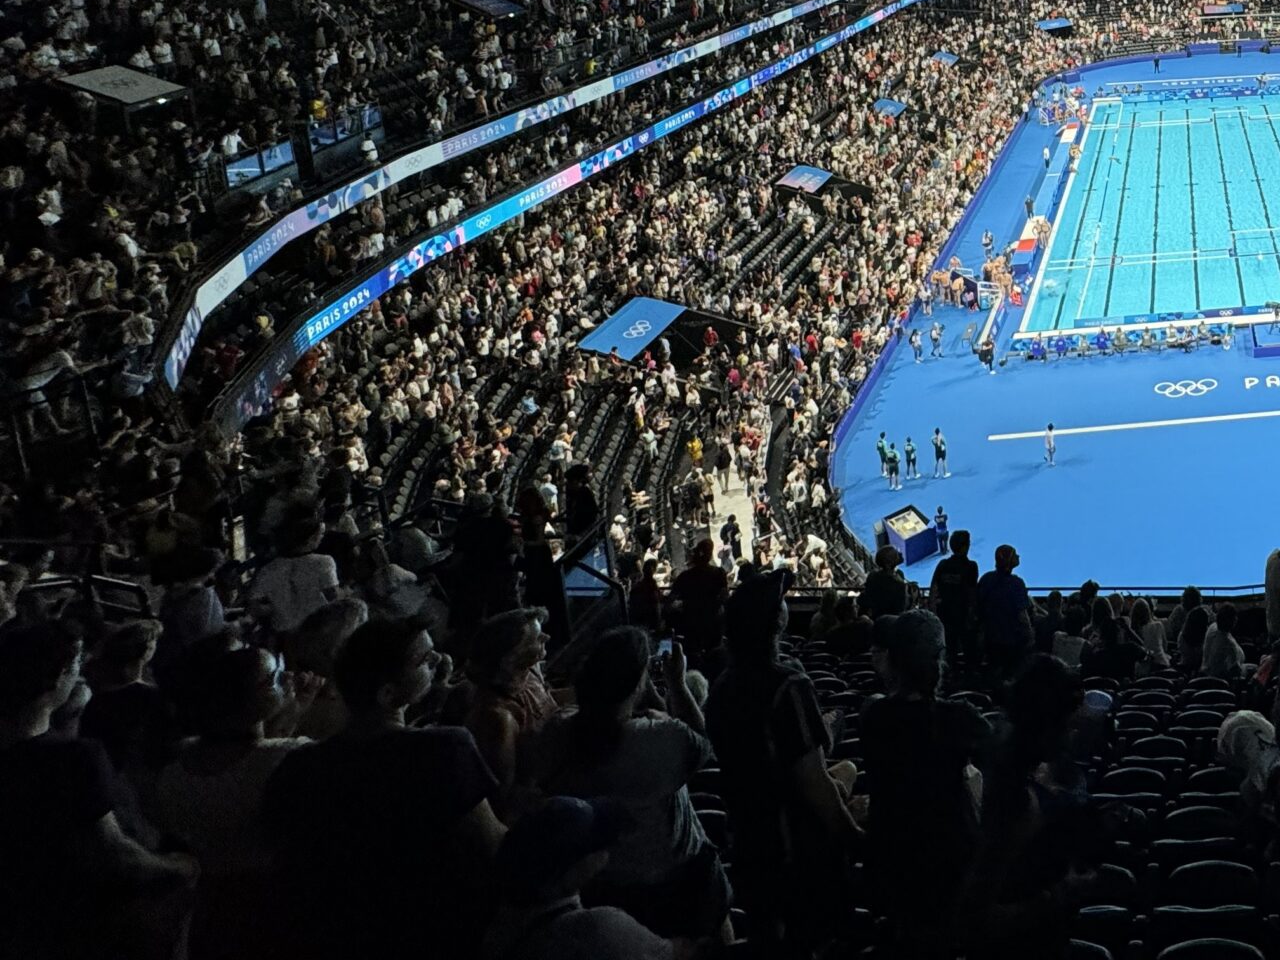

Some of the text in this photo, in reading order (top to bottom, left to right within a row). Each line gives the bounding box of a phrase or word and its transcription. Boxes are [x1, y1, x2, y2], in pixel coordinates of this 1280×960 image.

[447, 123, 506, 153] PARIS 2024
[519, 189, 545, 207] PARIS
[247, 221, 295, 267] PARIS 2024
[307, 288, 370, 341] PARIS 2024
